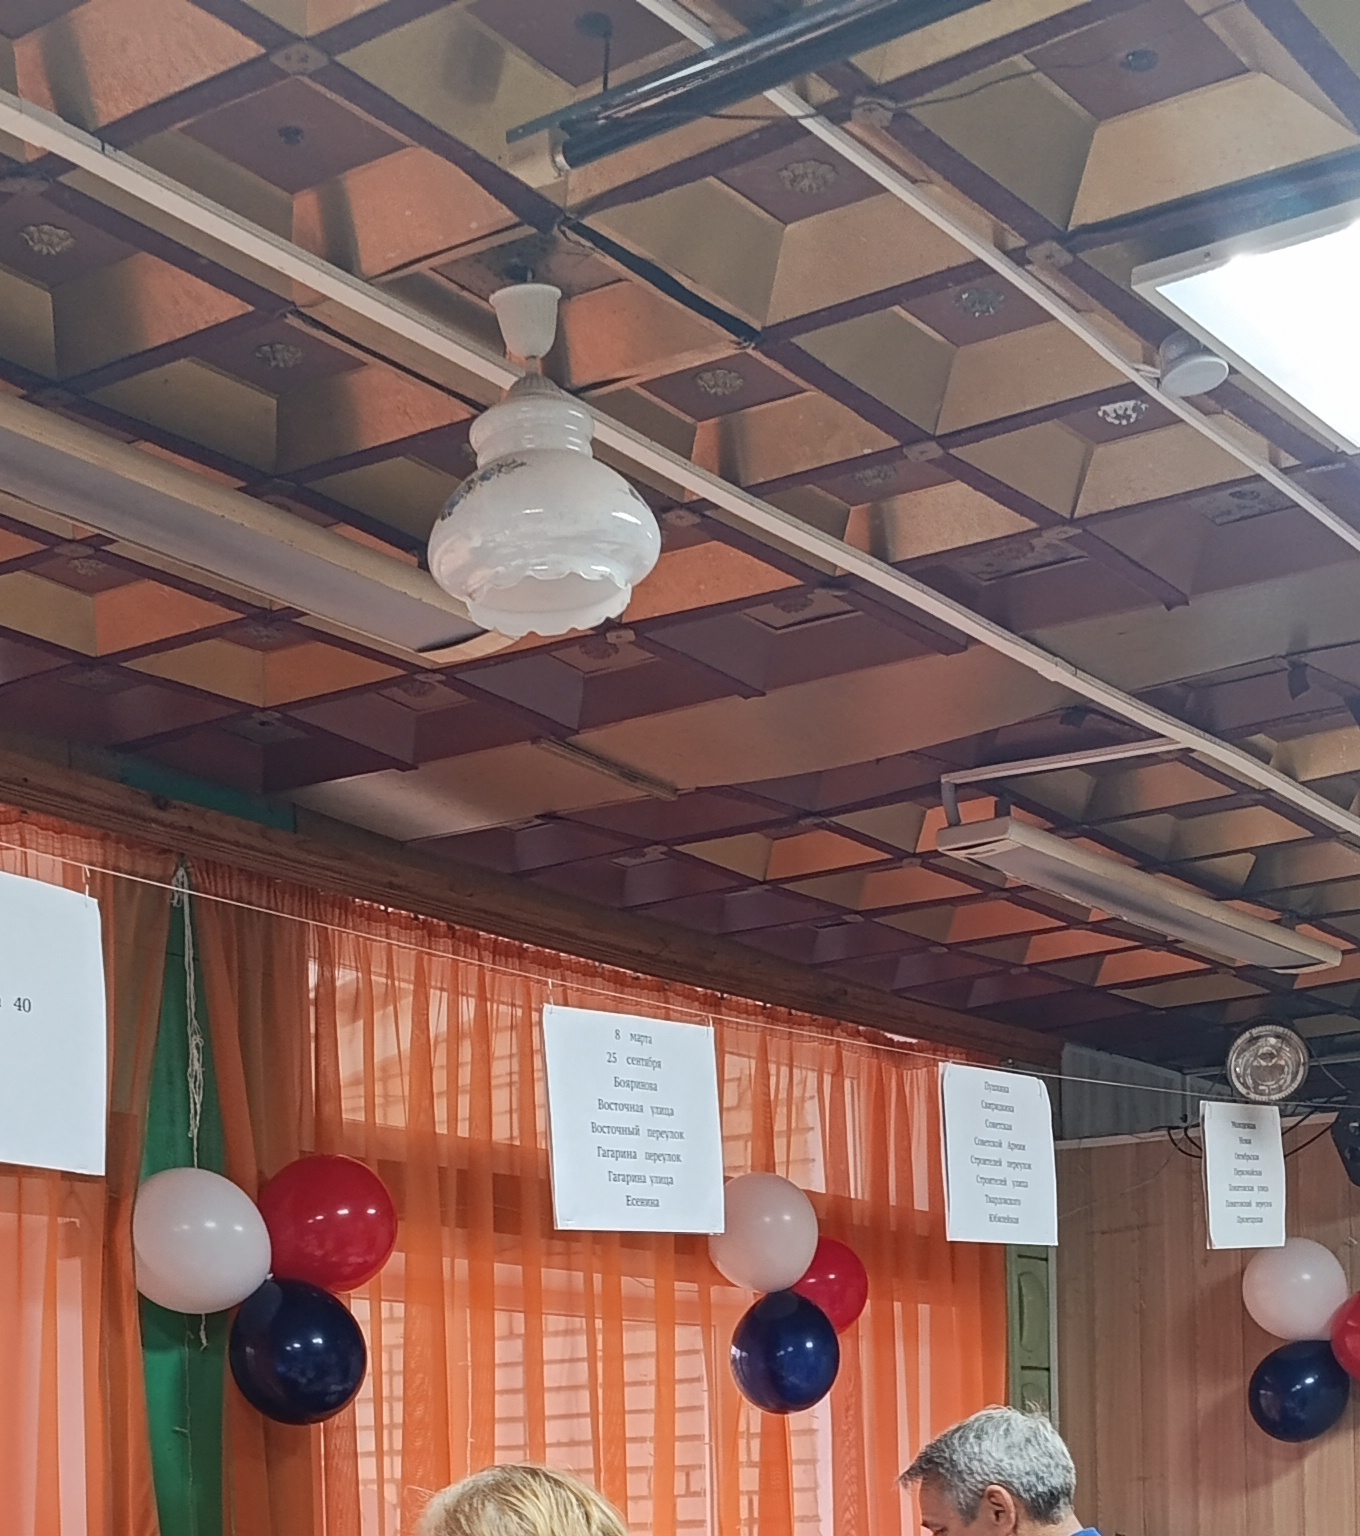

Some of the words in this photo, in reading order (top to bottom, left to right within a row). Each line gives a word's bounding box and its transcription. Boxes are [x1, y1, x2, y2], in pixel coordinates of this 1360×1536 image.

[13, 996, 32, 1014] 40
[614, 1029, 621, 1041] 8
[629, 1032, 653, 1046] марта
[606, 1051, 618, 1064] 25
[626, 1056, 662, 1071] сентября
[613, 1076, 658, 1093] Бояринова
[597, 1098, 644, 1114] Восточная
[650, 1105, 675, 1118] улица
[590, 1121, 640, 1137] Восточный
[647, 1128, 685, 1142] переулок
[596, 1146, 638, 1162] Гагарина
[644, 1151, 683, 1165] переулок
[607, 1170, 647, 1186] Гагарина
[649, 1174, 675, 1187] улица
[625, 1195, 660, 1208] Есенина
